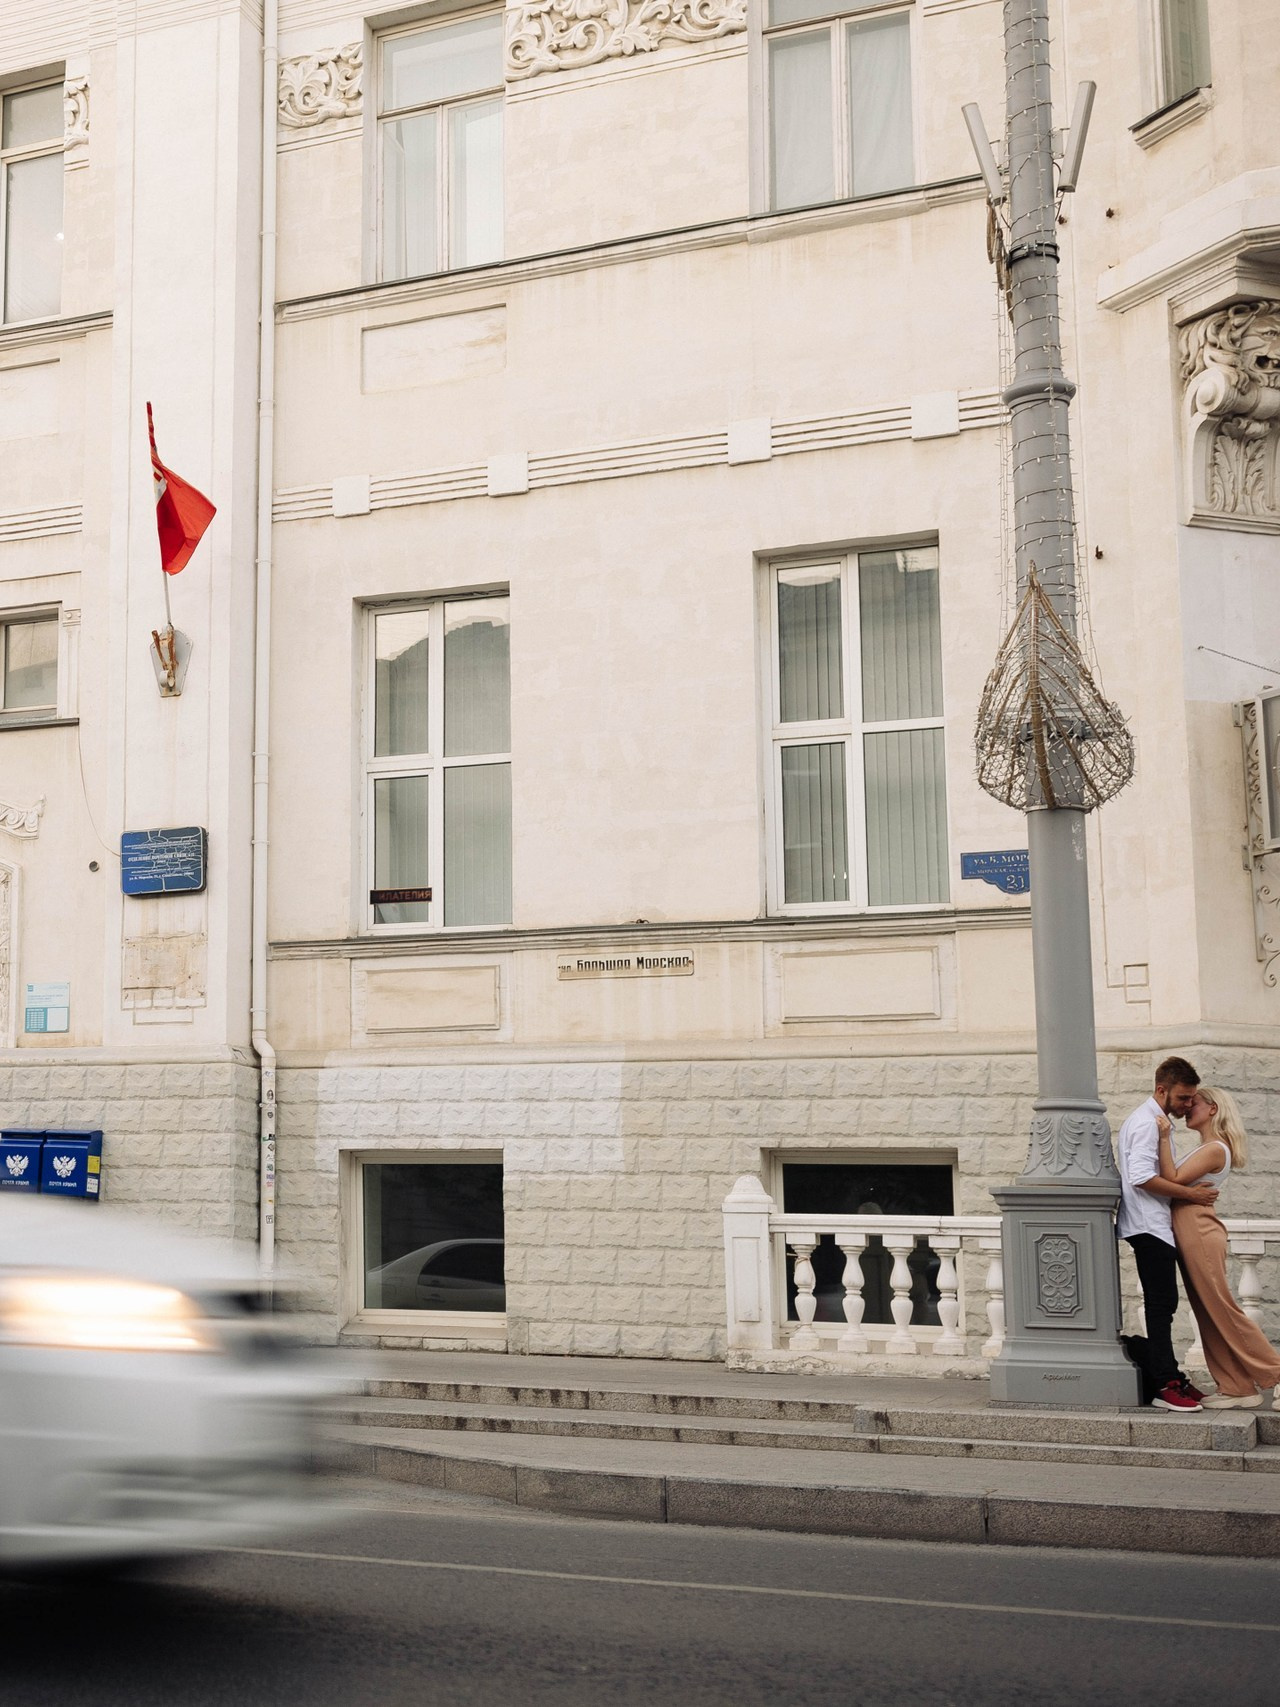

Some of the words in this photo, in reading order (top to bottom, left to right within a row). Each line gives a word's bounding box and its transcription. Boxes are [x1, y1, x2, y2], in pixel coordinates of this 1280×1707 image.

[973, 858, 987, 866] ул.
[989, 855, 1000, 864] Б.
[1006, 874, 1025, 890] 21
